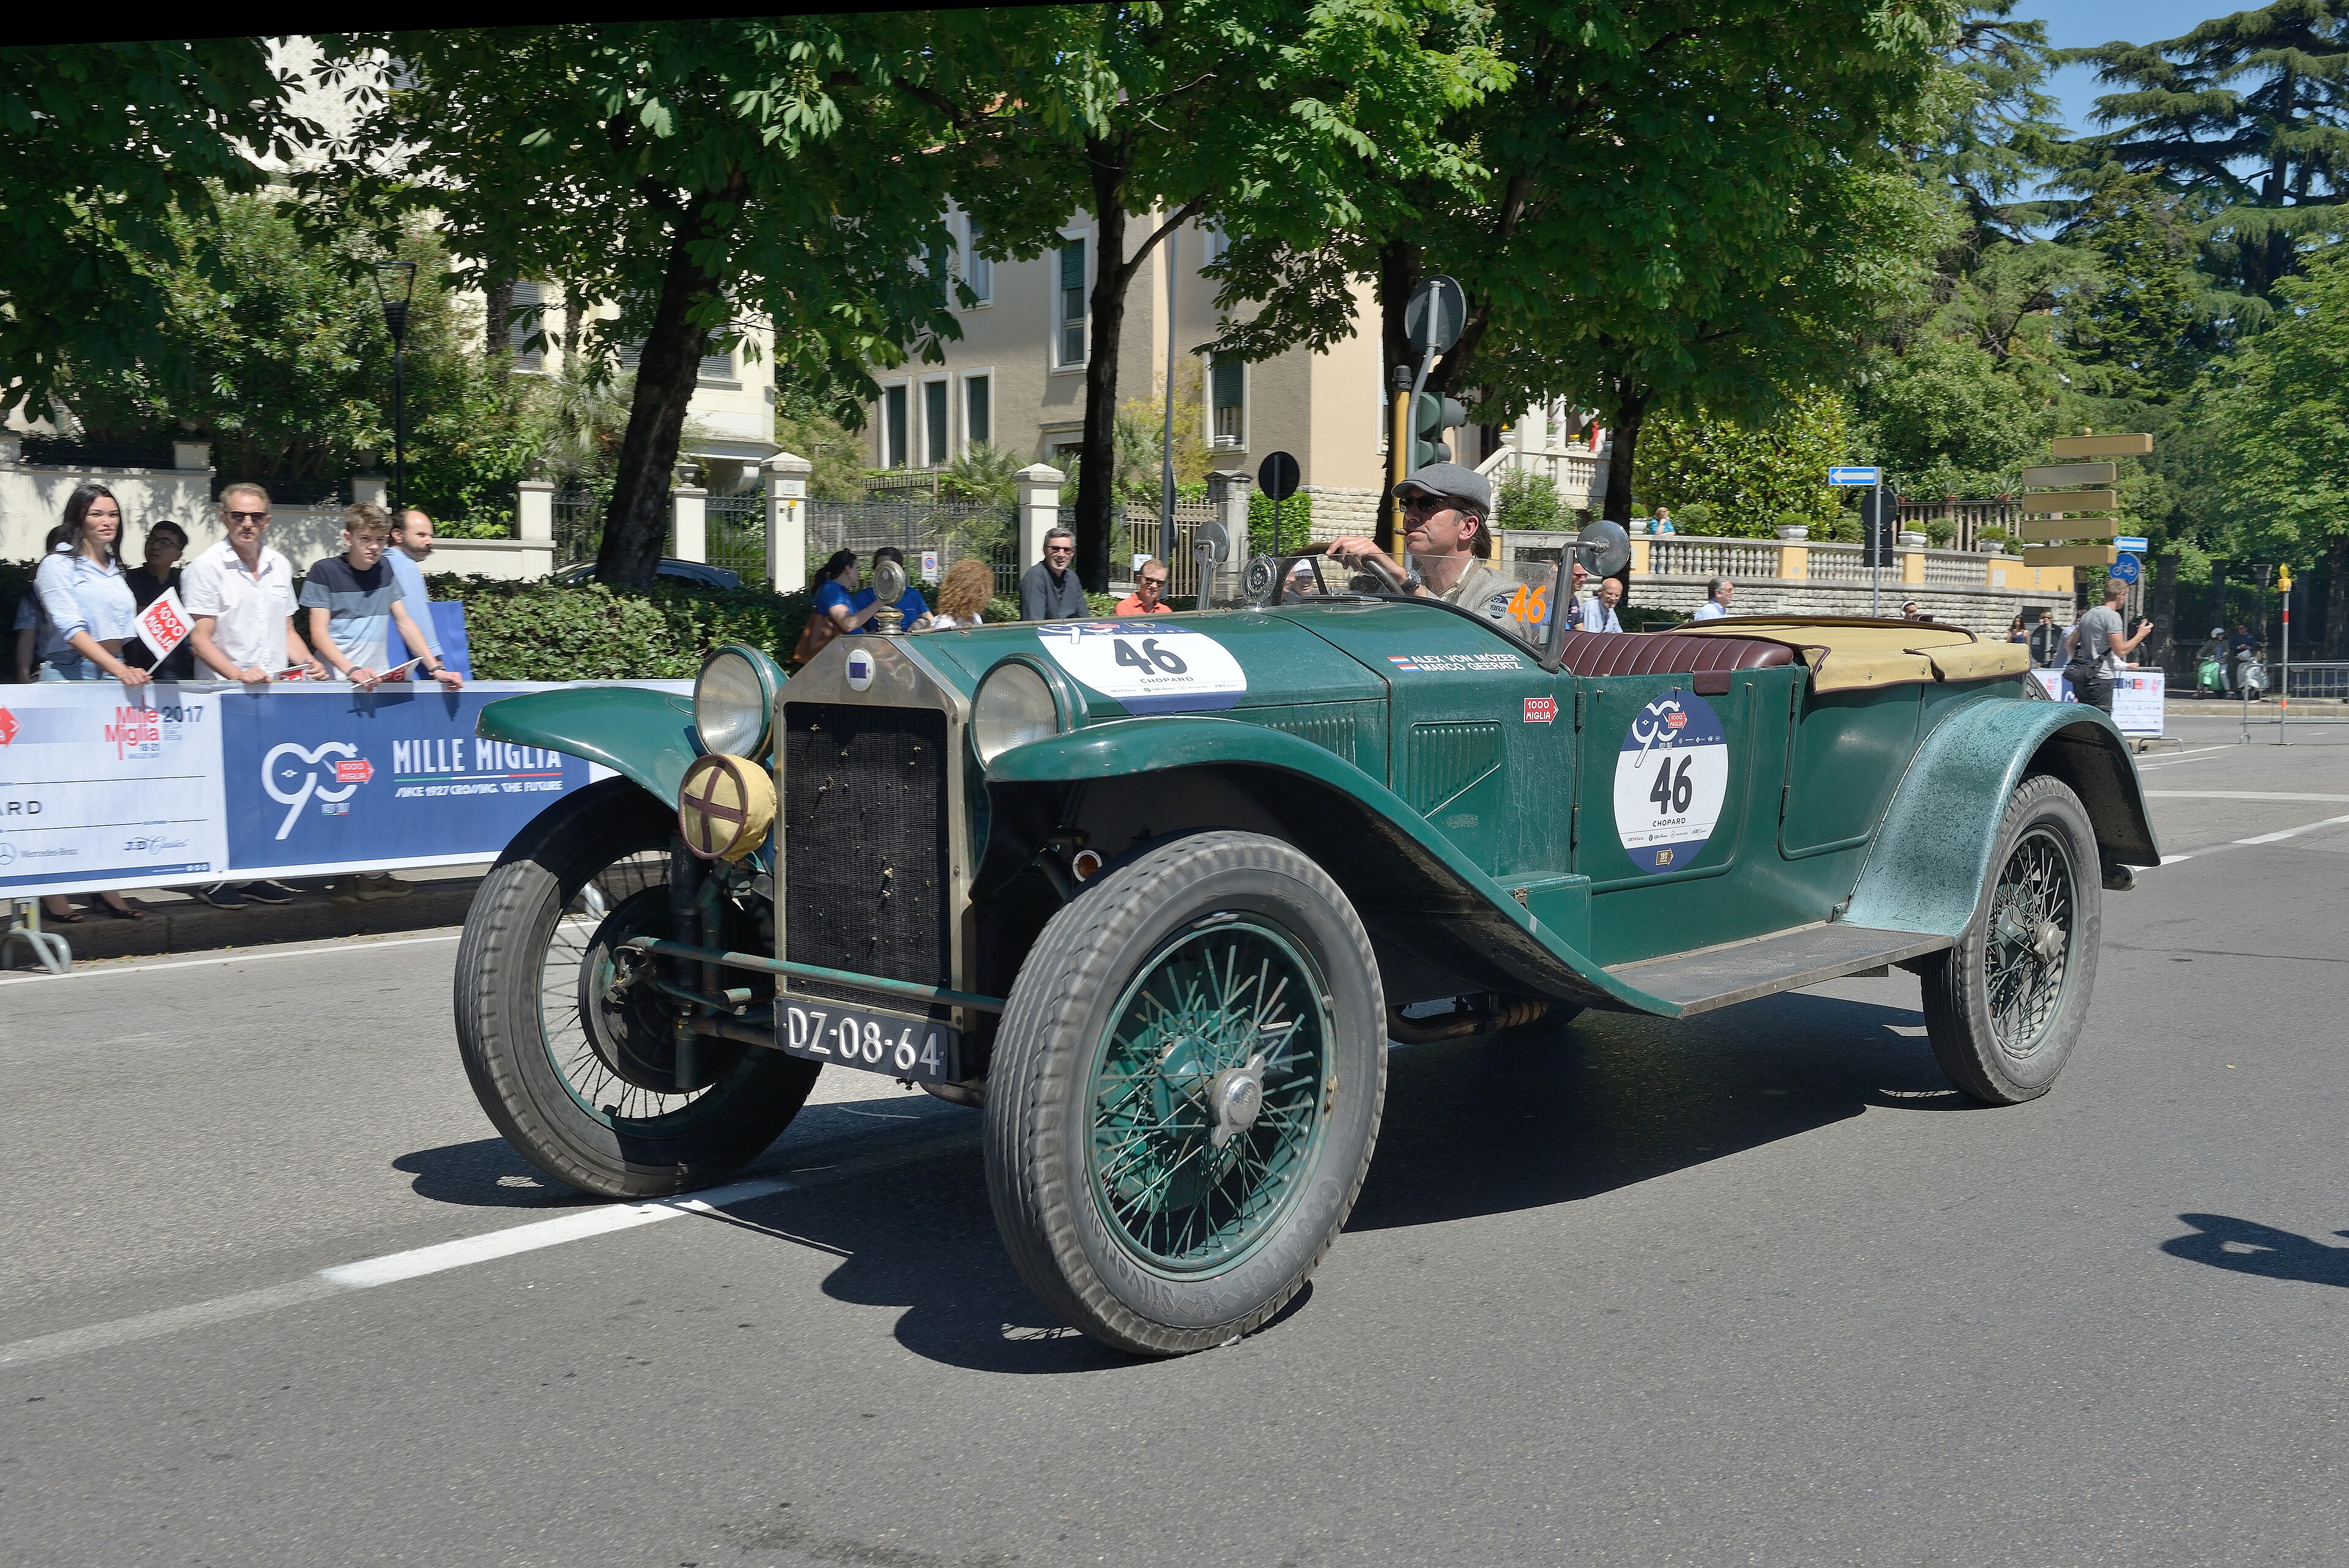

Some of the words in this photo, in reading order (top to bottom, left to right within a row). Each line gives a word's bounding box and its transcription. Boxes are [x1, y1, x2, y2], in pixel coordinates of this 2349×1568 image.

[1507, 584, 1546, 623] 46
[157, 606, 185, 637] 1000
[1113, 638, 1188, 675] 46
[1411, 655, 1447, 664] ALEX
[1442, 654, 1475, 663] VON
[1417, 663, 1467, 672] MARCO
[1466, 661, 1524, 671] GEERATZ
[162, 705, 204, 723] 2017
[1526, 711, 1551, 720] MIGLIA
[1527, 700, 1549, 709] 1000
[104, 724, 160, 759] Miglia
[392, 738, 466, 774] MILLE
[475, 738, 562, 771] MIGLIA
[1650, 754, 1693, 815] 46
[1652, 817, 1686, 827] CHOPARD
[787, 1006, 941, 1076] DZ-08-64
[1231, 1175, 1344, 1301] Goodrich
